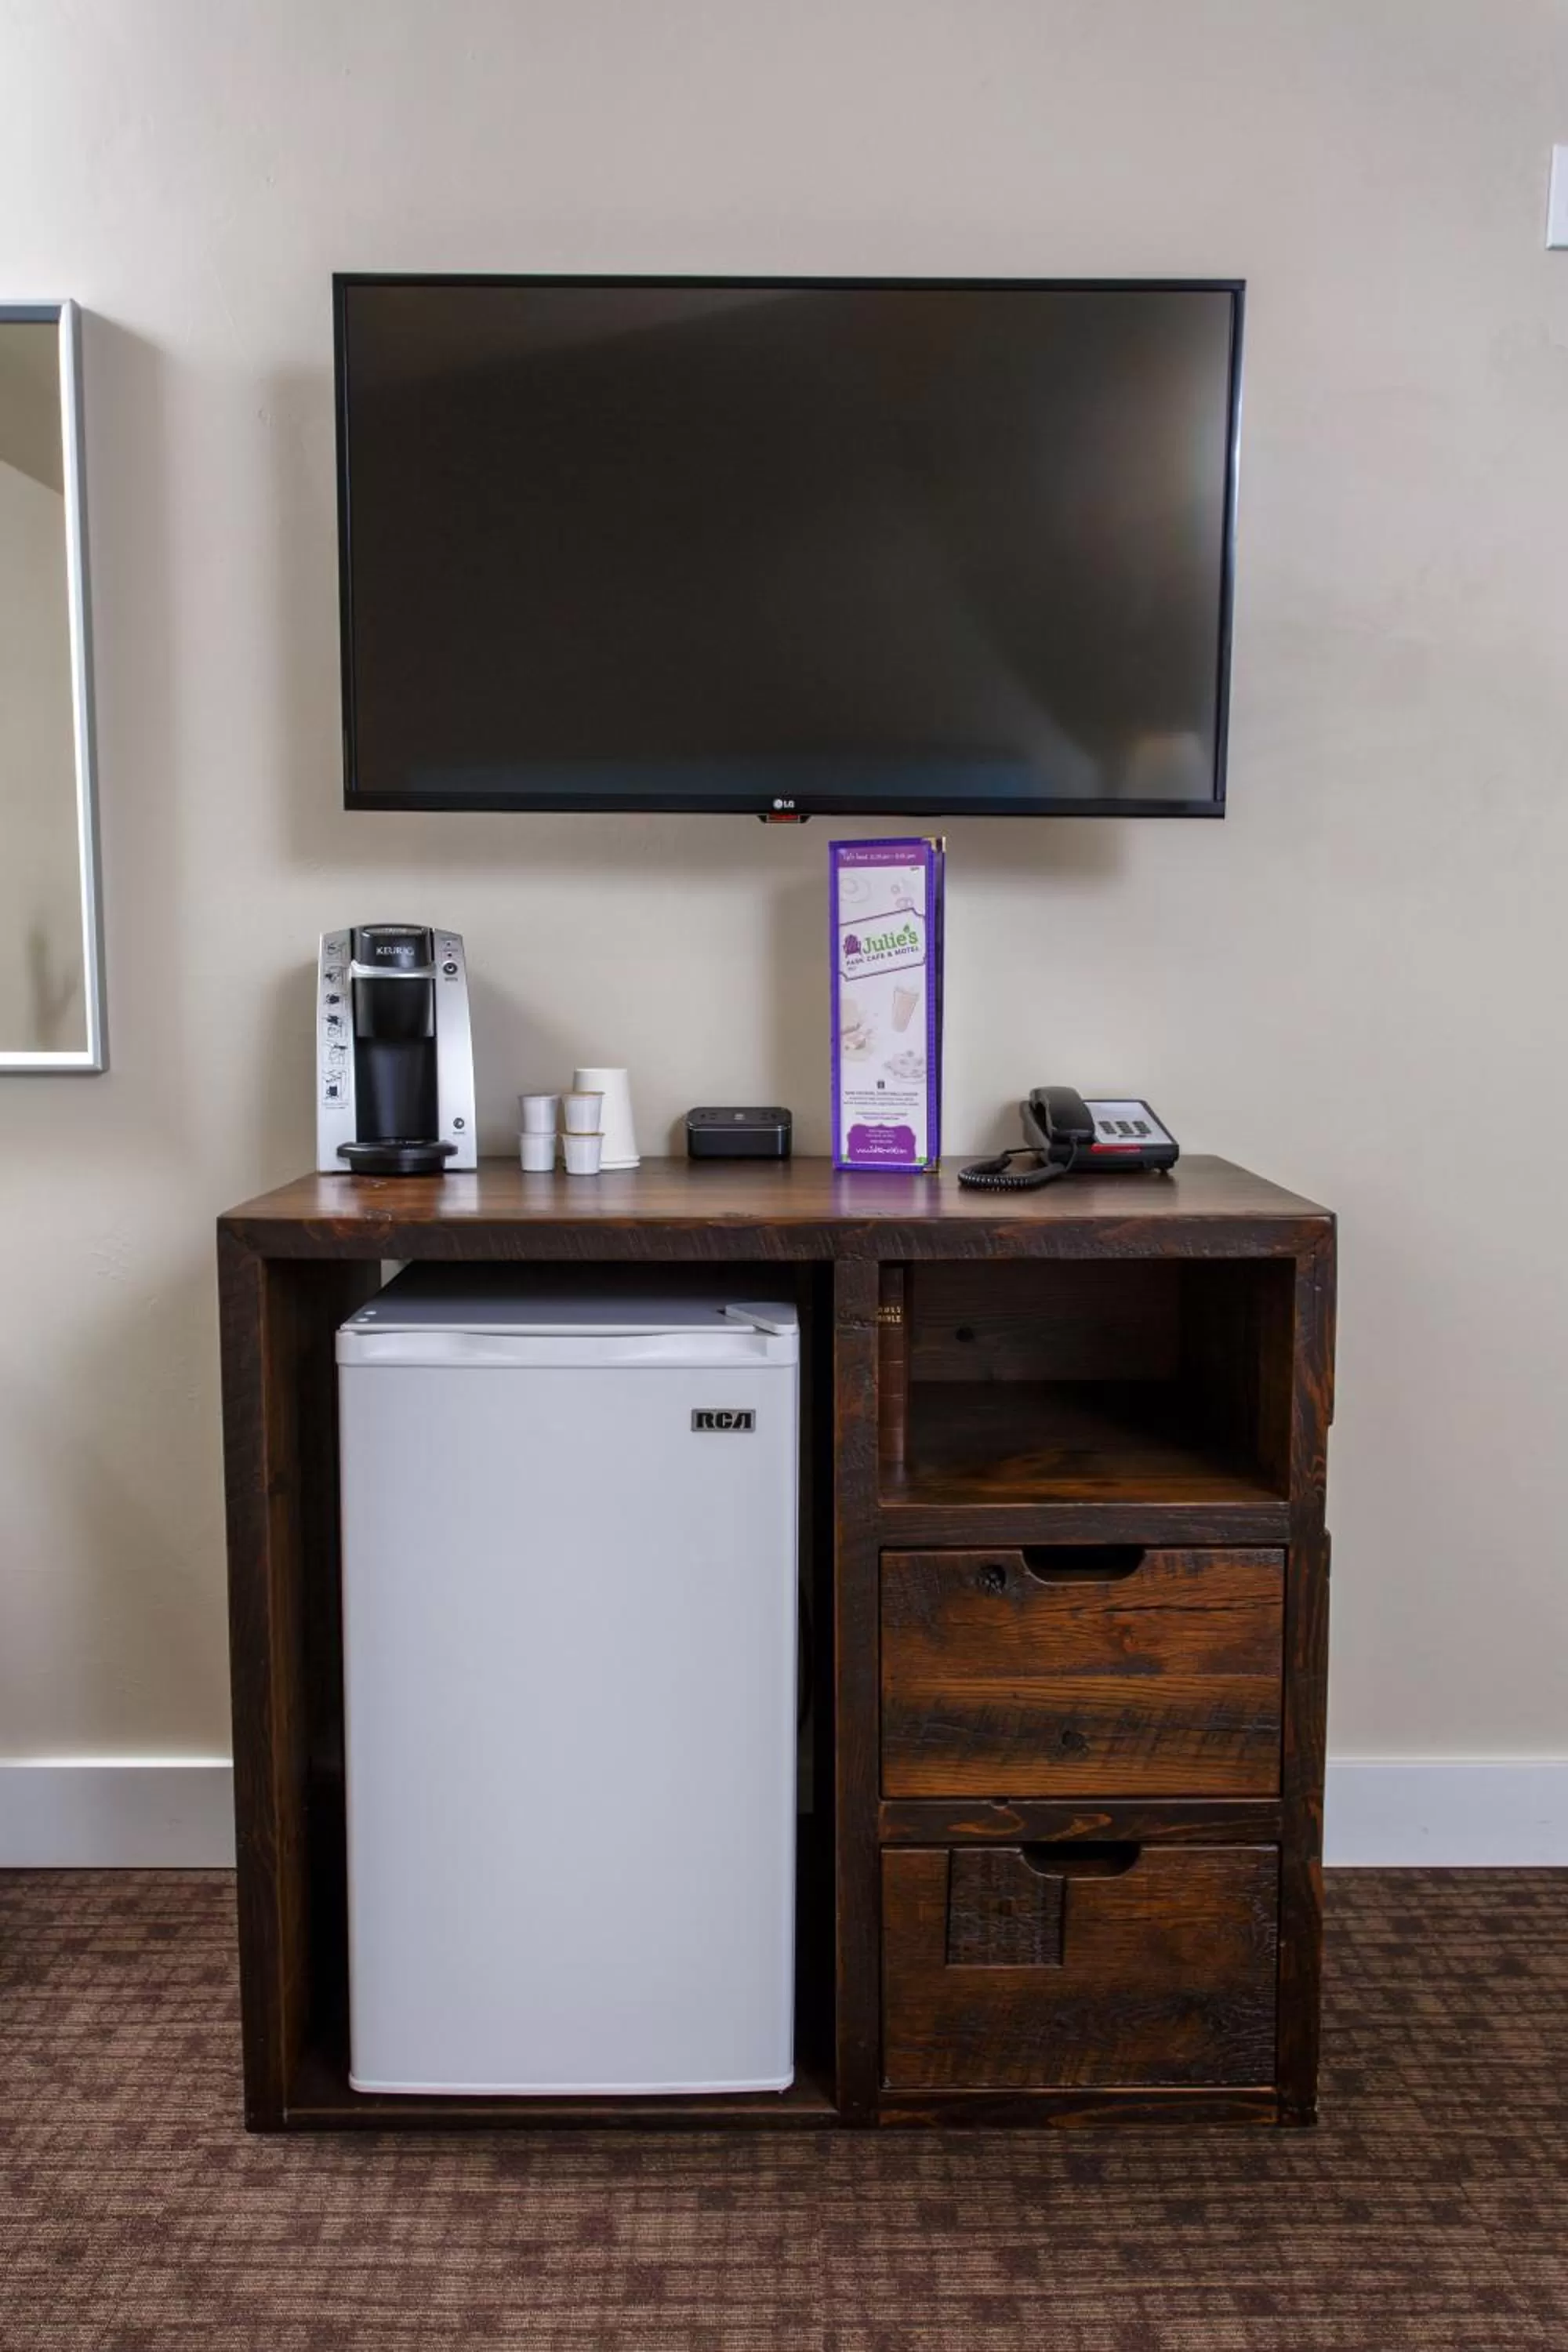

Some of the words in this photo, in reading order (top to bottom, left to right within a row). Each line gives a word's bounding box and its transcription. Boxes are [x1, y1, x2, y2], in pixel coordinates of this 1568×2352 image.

[783, 800, 795, 808] LG
[862, 924, 918, 954] Julie's
[376, 946, 415, 956] KEURIG
[695, 1411, 753, 1429] RCA
